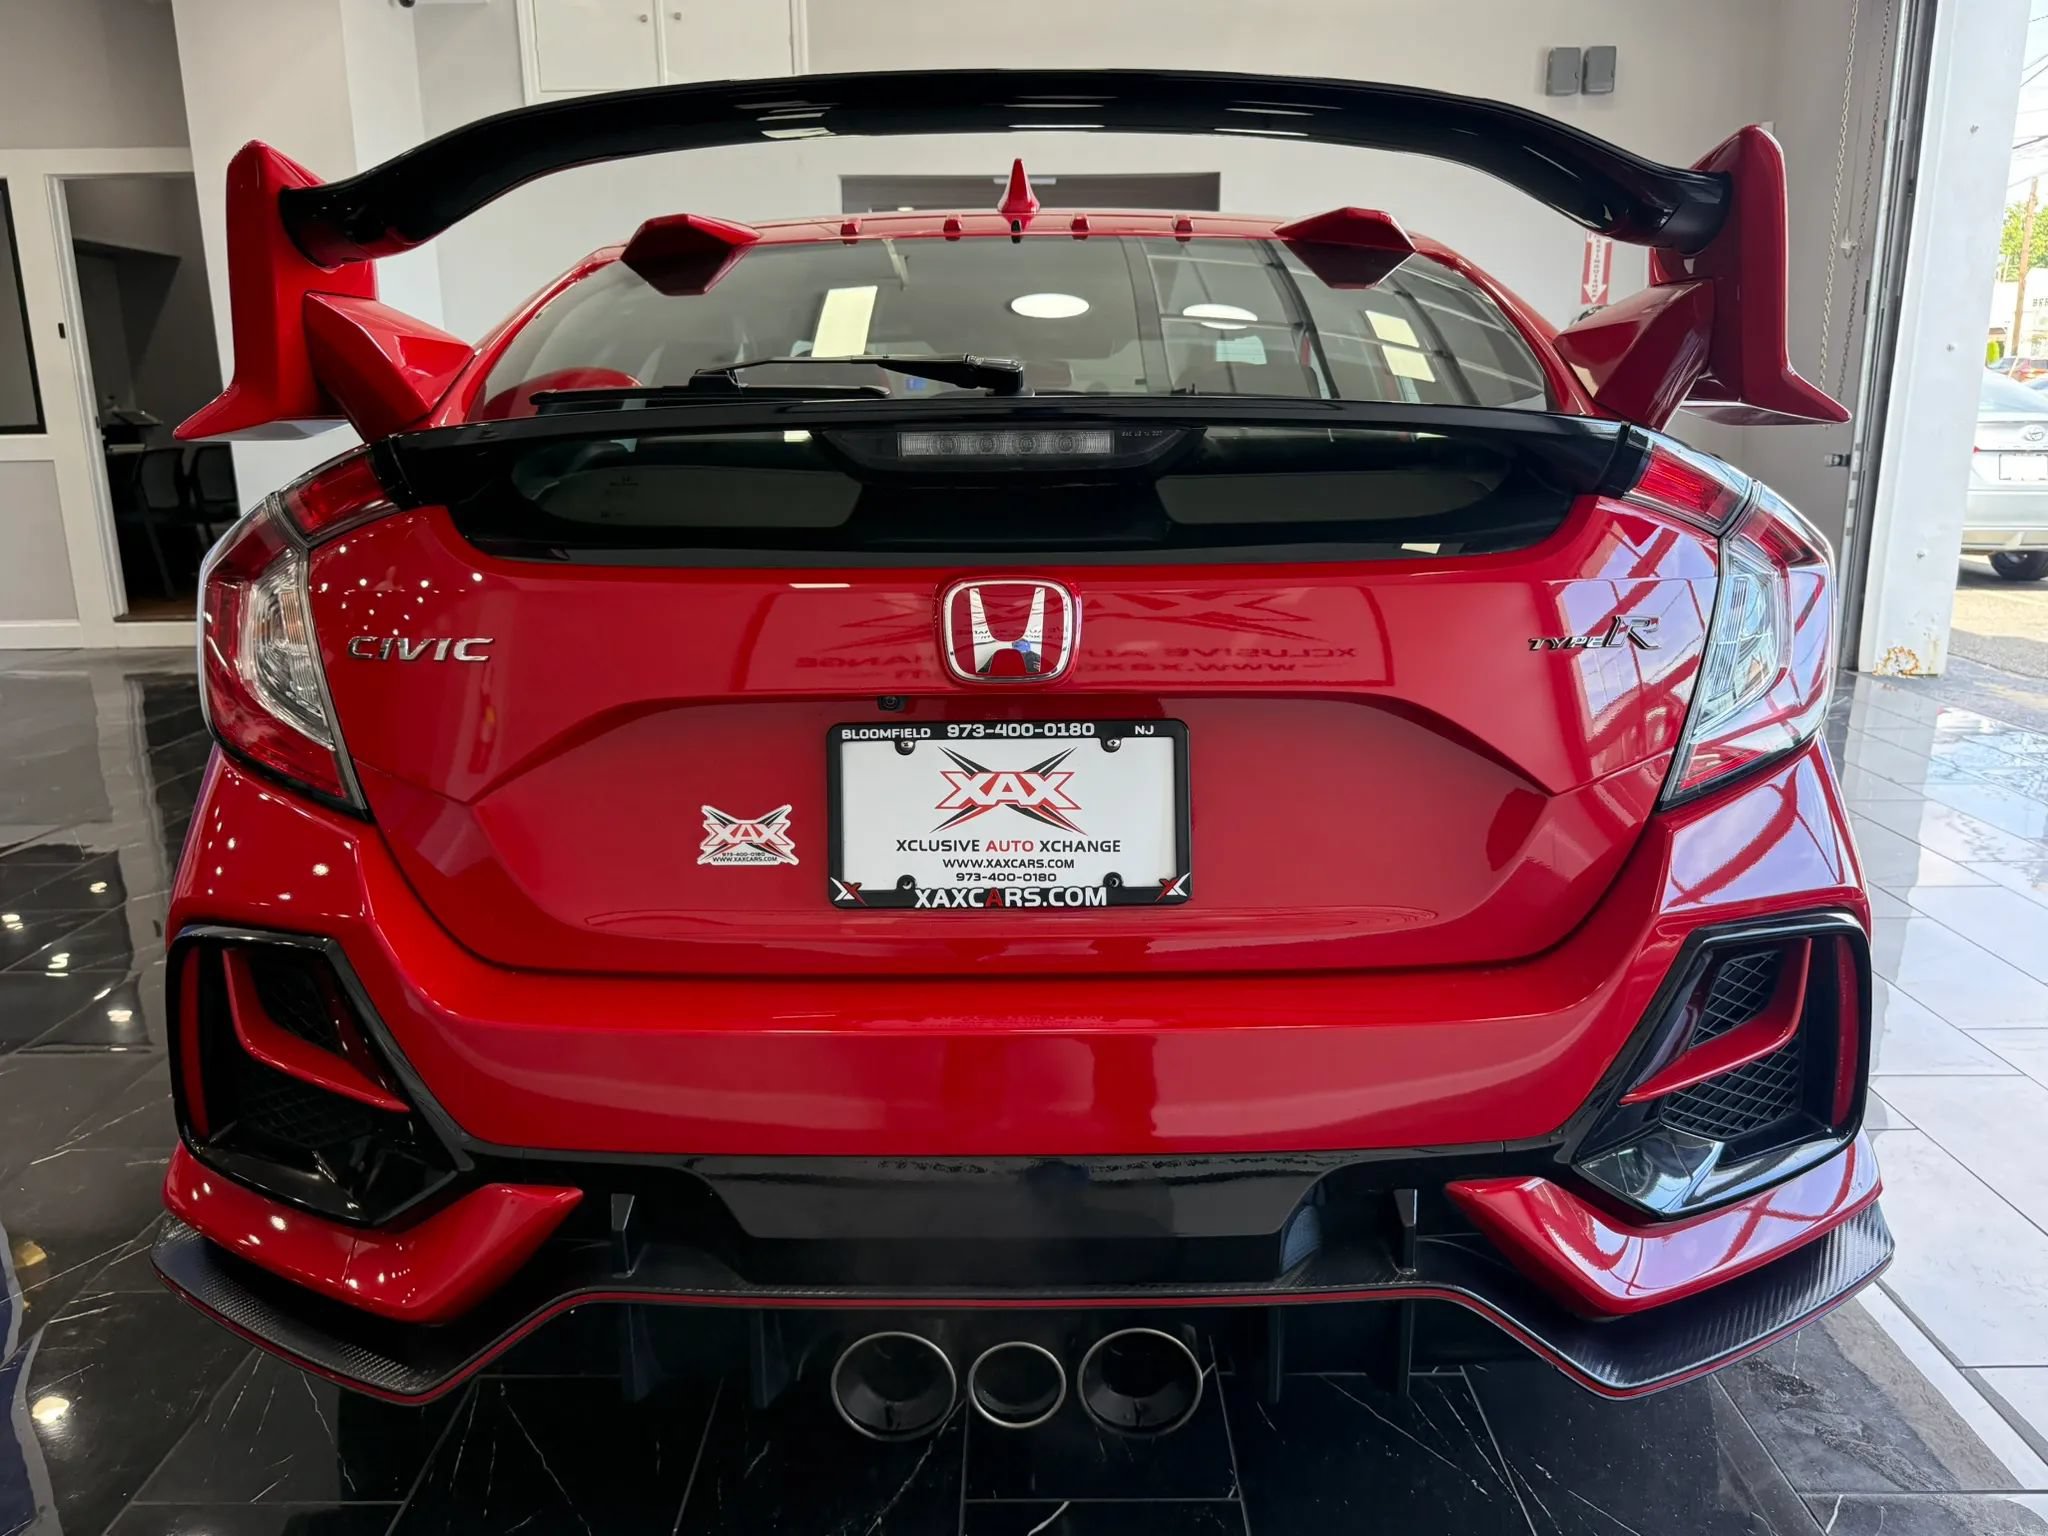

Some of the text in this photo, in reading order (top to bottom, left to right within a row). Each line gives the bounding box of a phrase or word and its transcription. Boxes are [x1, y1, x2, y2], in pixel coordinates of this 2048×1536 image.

[1528, 615, 1662, 651] TYPE R
[347, 635, 494, 661] CIVIC
[841, 722, 1155, 740] BLOOMFIELD 973-400-0180 NJ
[935, 770, 1082, 810] XAX
[704, 822, 791, 847] XAX
[896, 839, 1122, 853] XCLUSIVE AUTO XCHANGE
[942, 858, 1075, 869] WWW.XAXCARS.COM
[955, 872, 1057, 882] 973-400-0180
[914, 886, 1107, 908] XAXCARS.COM
